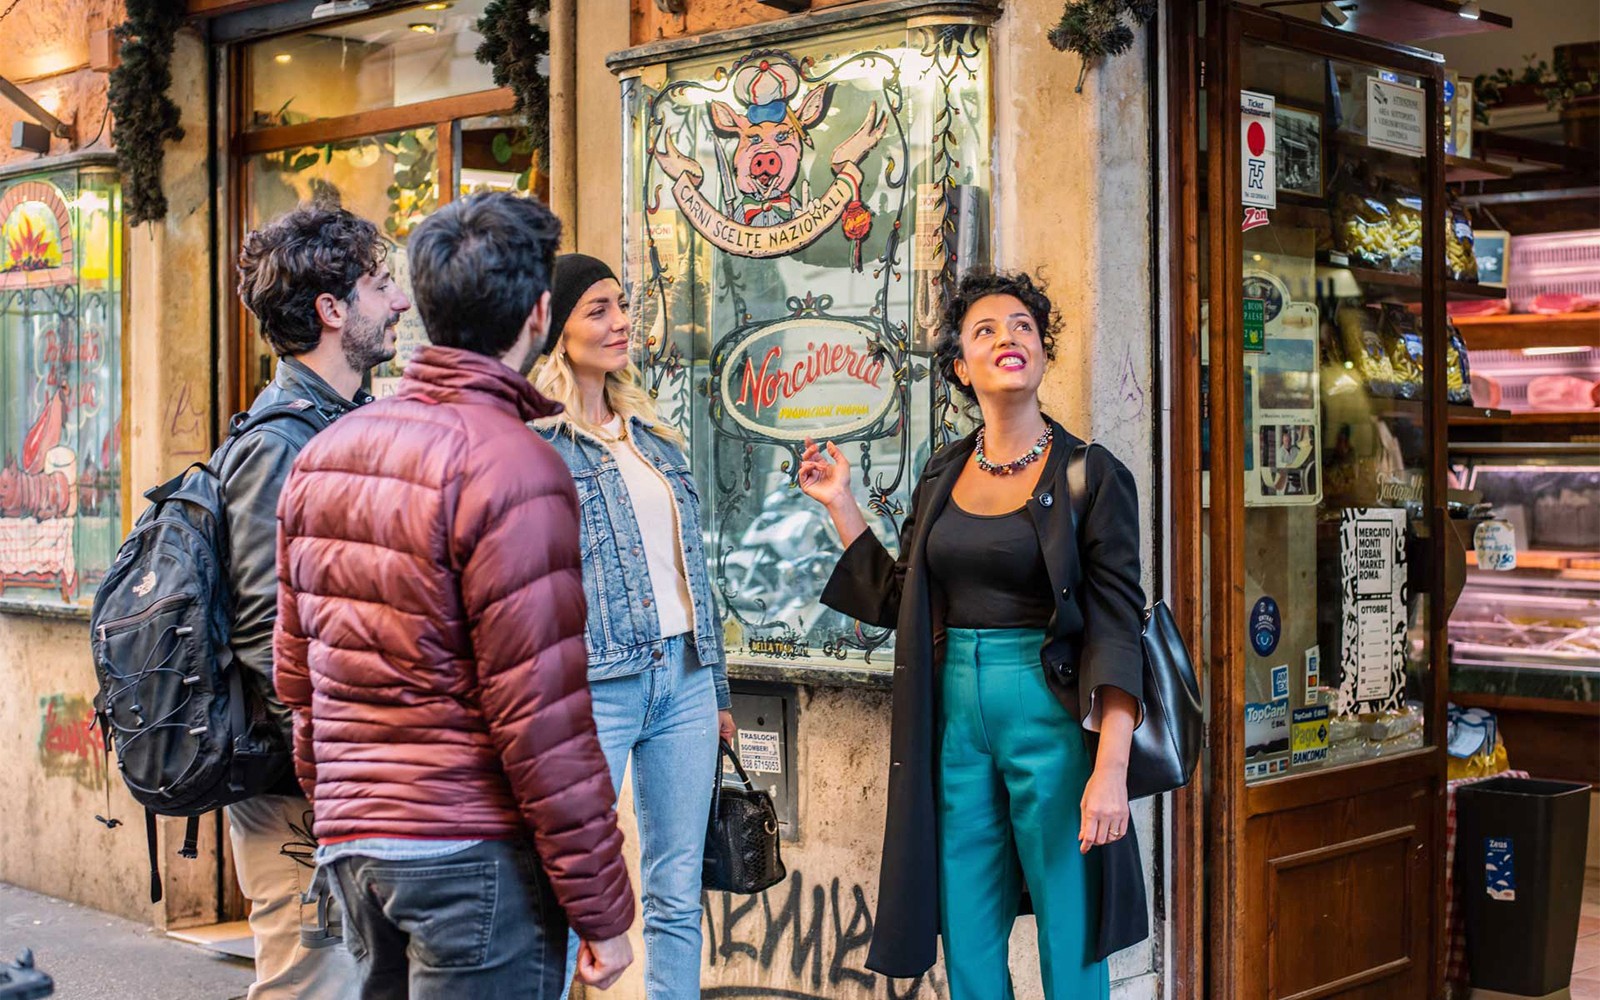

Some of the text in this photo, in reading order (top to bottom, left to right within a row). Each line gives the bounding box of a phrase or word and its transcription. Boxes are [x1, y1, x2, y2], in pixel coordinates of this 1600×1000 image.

[1247, 99, 1265, 110] Ticket
[680, 185, 844, 249] CARNI SCELTE NAZIONALI
[735, 341, 882, 419] Norcineria
[1359, 528, 1390, 537] MERCATO
[1359, 538, 1380, 548] MONTI
[1359, 549, 1381, 558] URBAN
[1359, 560, 1385, 569] MARKET
[1359, 570, 1379, 580] ROMA
[1361, 605, 1388, 614] OTTOBRE
[1247, 702, 1287, 724] TopCard
[1294, 711, 1313, 720] TopCash
[740, 733, 778, 741] TRASLOCHI
[1293, 725, 1317, 747] Pago
[1293, 748, 1328, 764] BANCOMAT
[1489, 840, 1508, 849] Zeus
